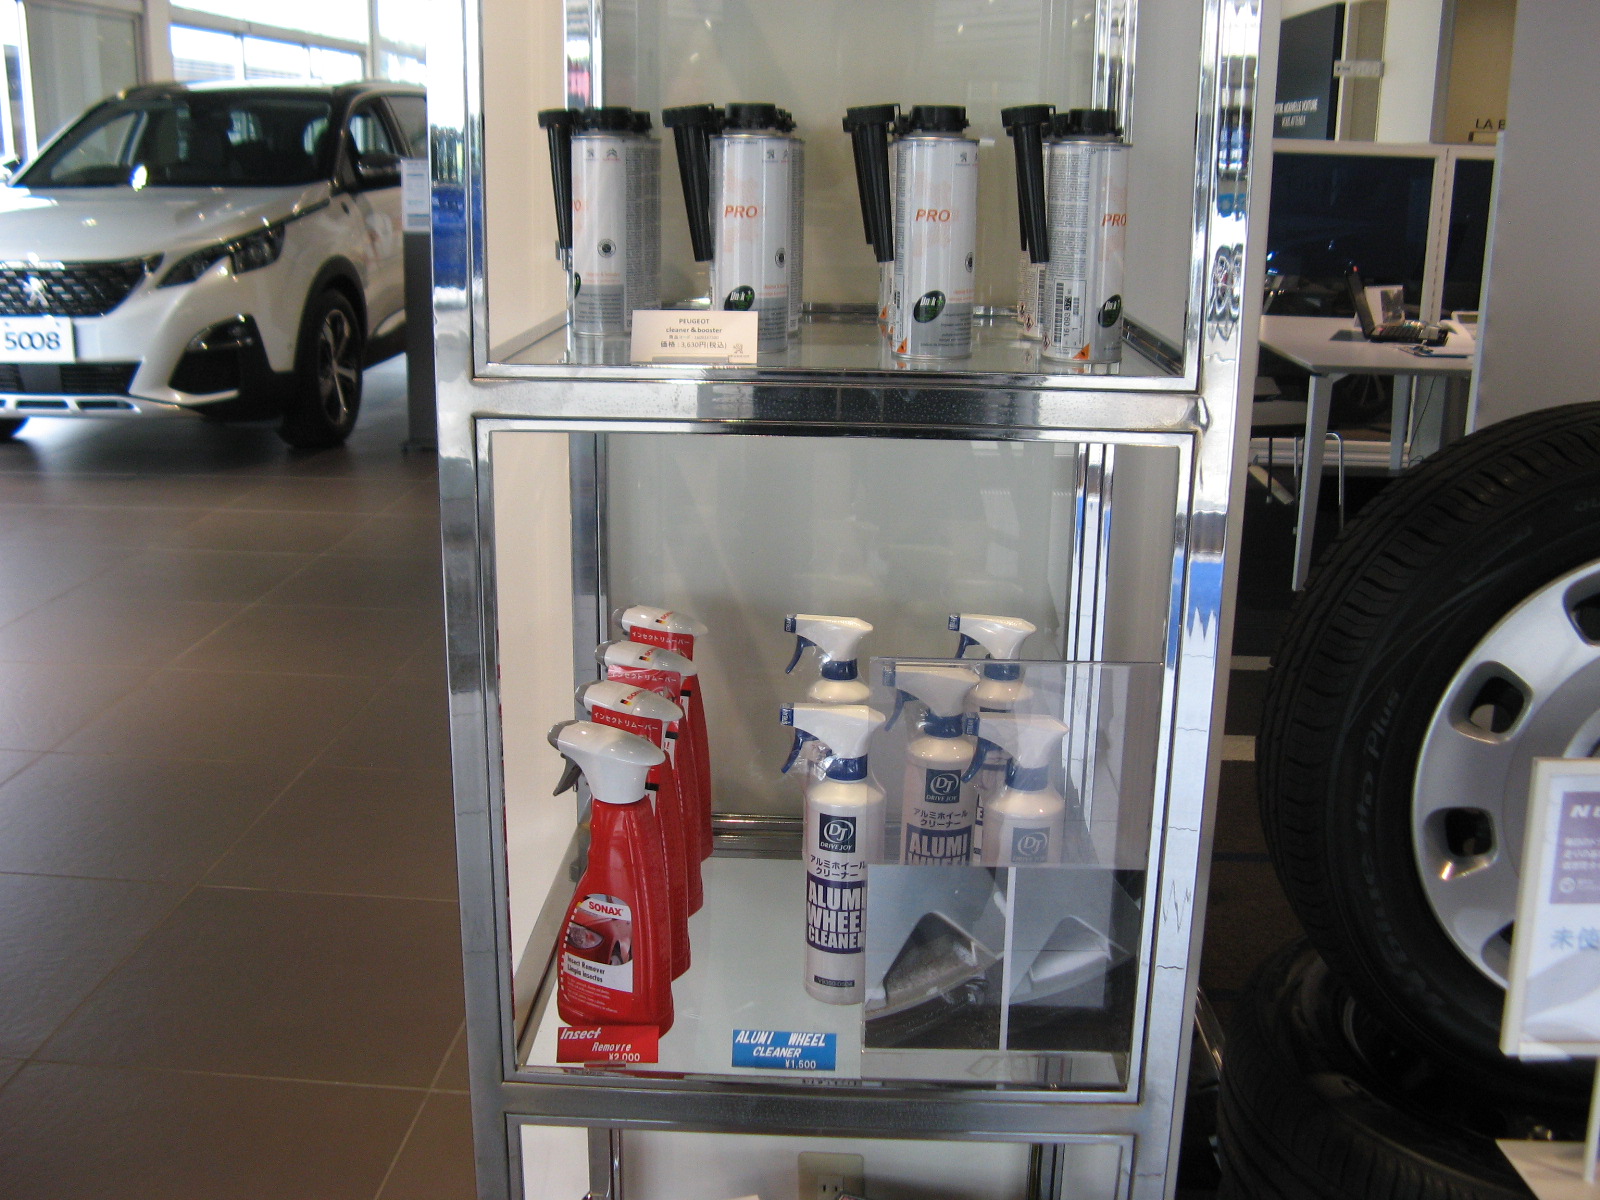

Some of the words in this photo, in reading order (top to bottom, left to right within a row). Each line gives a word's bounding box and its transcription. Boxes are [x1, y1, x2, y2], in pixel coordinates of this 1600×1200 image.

[1475, 118, 1493, 129] LA
[725, 205, 758, 219] PRO
[916, 208, 950, 223] PRO
[1101, 213, 1127, 228] PRO
[5, 332, 61, 351] 5008
[632, 631, 691, 645] インセクトリムーバー
[594, 712, 659, 731] インセクトリムーバー
[913, 807, 969, 821] アルミホイール
[920, 819, 961, 829] クリーナー
[820, 841, 838, 851] DRIVE
[909, 832, 968, 857] ALUMI
[810, 854, 867, 871] アルミホイール
[816, 866, 859, 880] クリーナー
[588, 900, 622, 917] SONAX
[567, 956, 581, 967] Insect
[581, 961, 606, 975] Remover
[559, 1027, 602, 1040] Insect
[735, 1030, 774, 1045] ALUMI
[788, 1032, 826, 1048] WHEEL
[592, 1042, 632, 1053] Removre
[753, 1046, 802, 1058] CLEANER
[608, 1053, 641, 1062] ¥2000
[785, 1059, 817, 1070] ¥1,600
